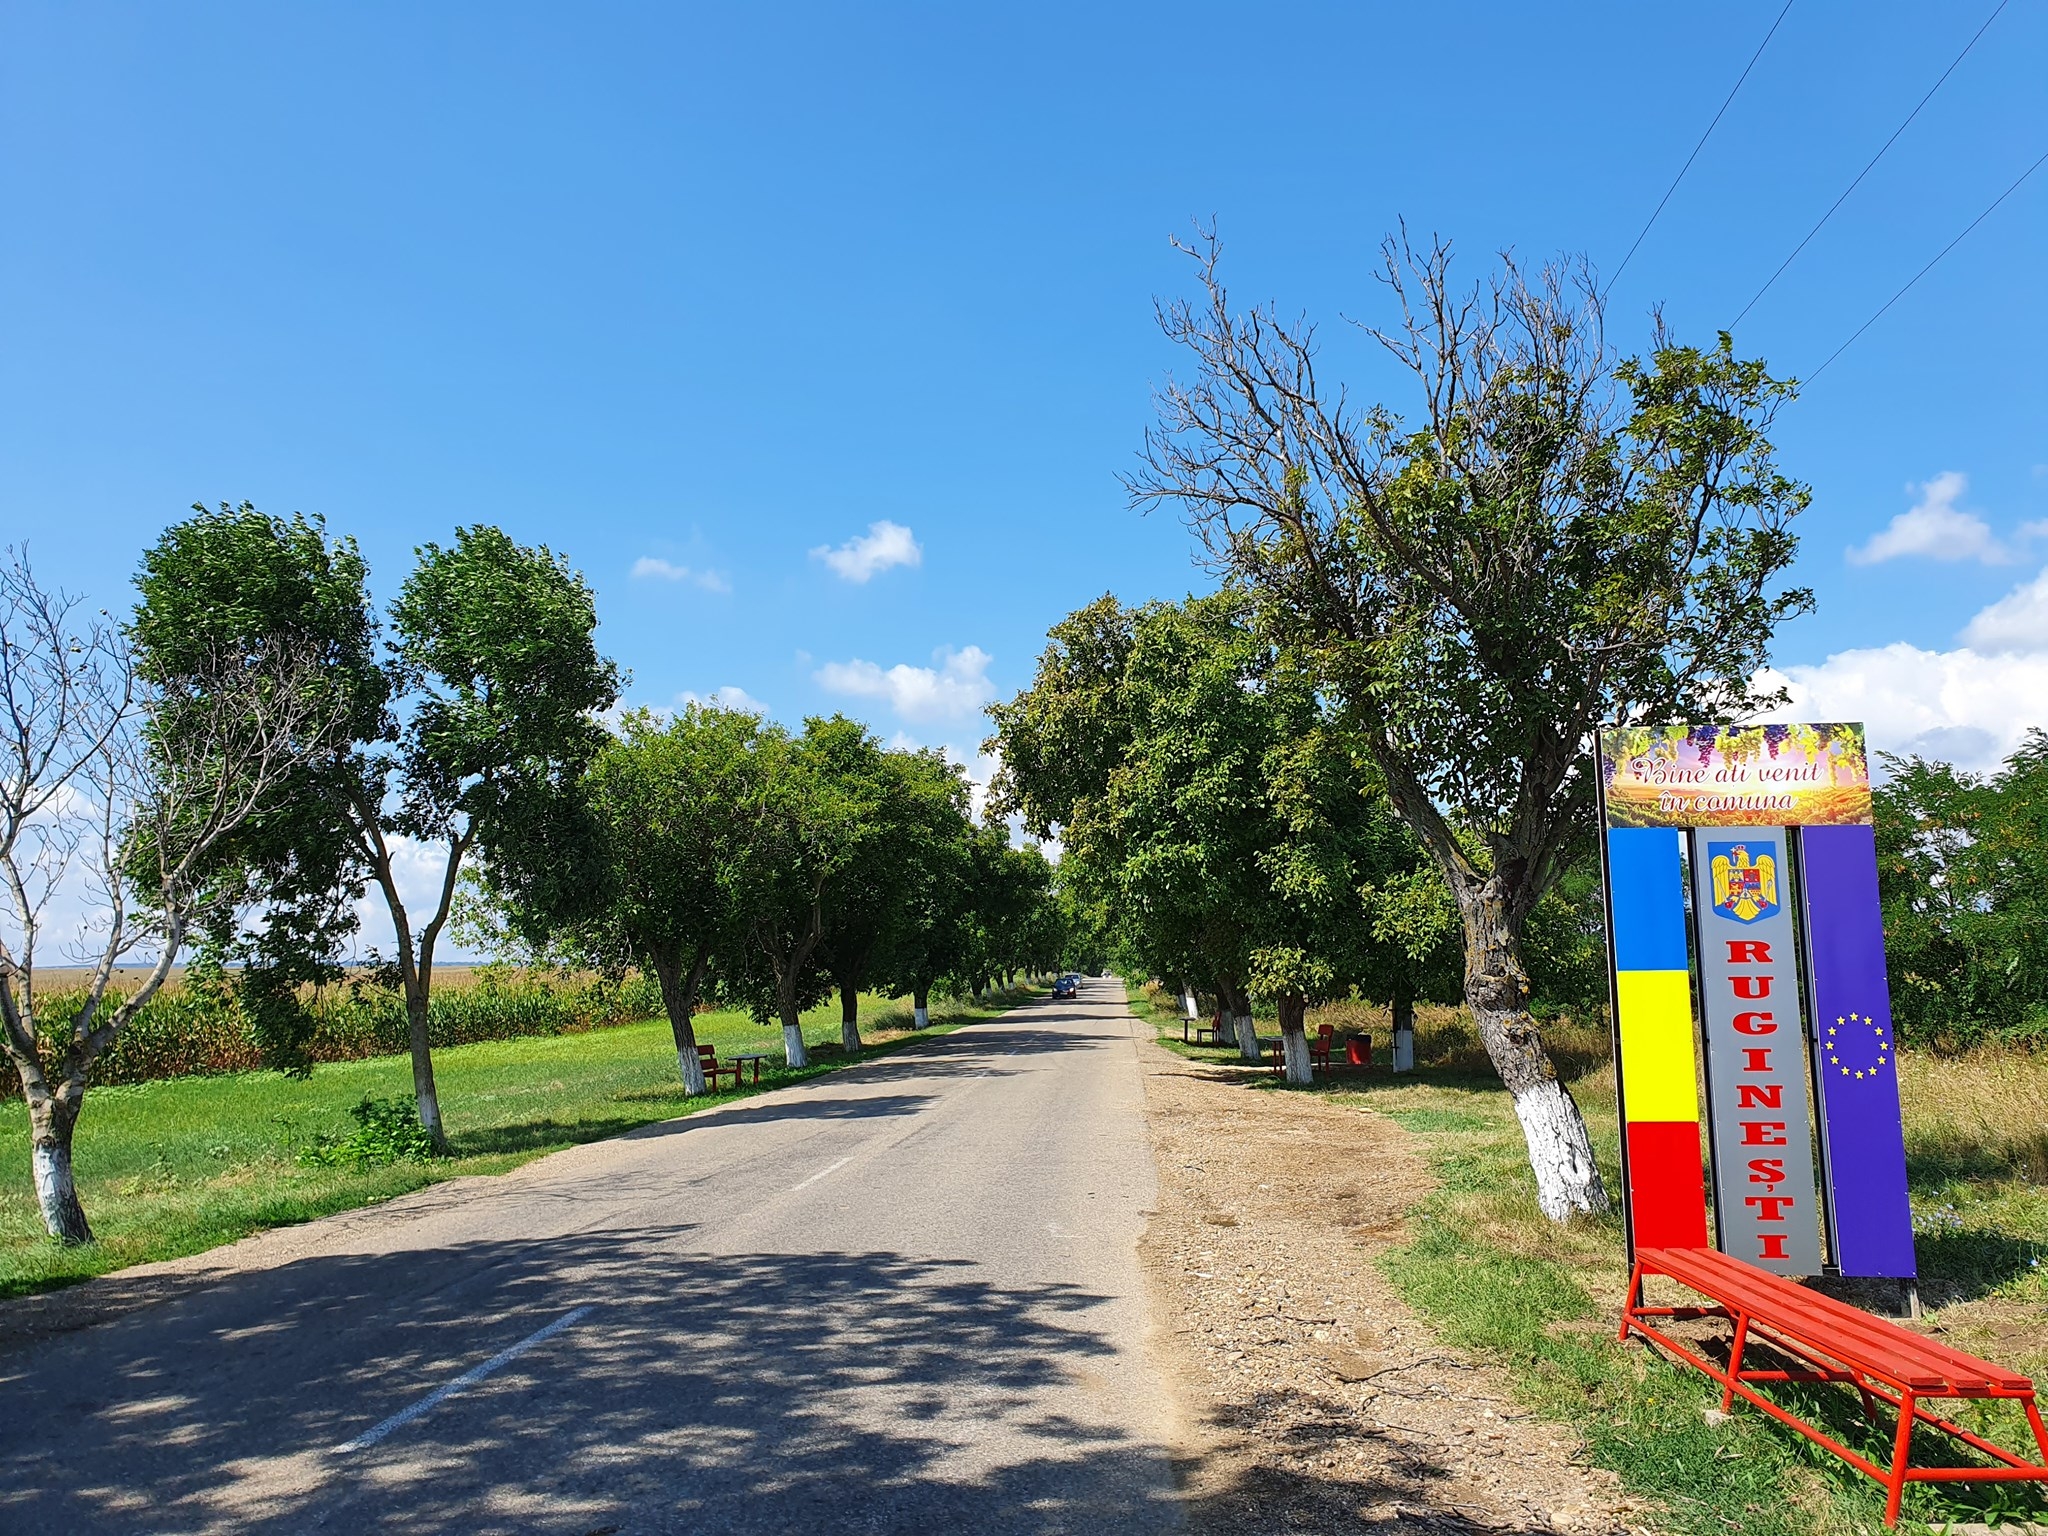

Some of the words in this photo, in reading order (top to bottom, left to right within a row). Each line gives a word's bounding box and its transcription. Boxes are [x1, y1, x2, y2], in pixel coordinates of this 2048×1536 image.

[1632, 757, 1709, 784] Bine
[1758, 761, 1823, 782] venit
[1660, 791, 1688, 811] în
[1694, 792, 1797, 811] comuna
[1725, 940, 1794, 1259] RUGINEȘTI
